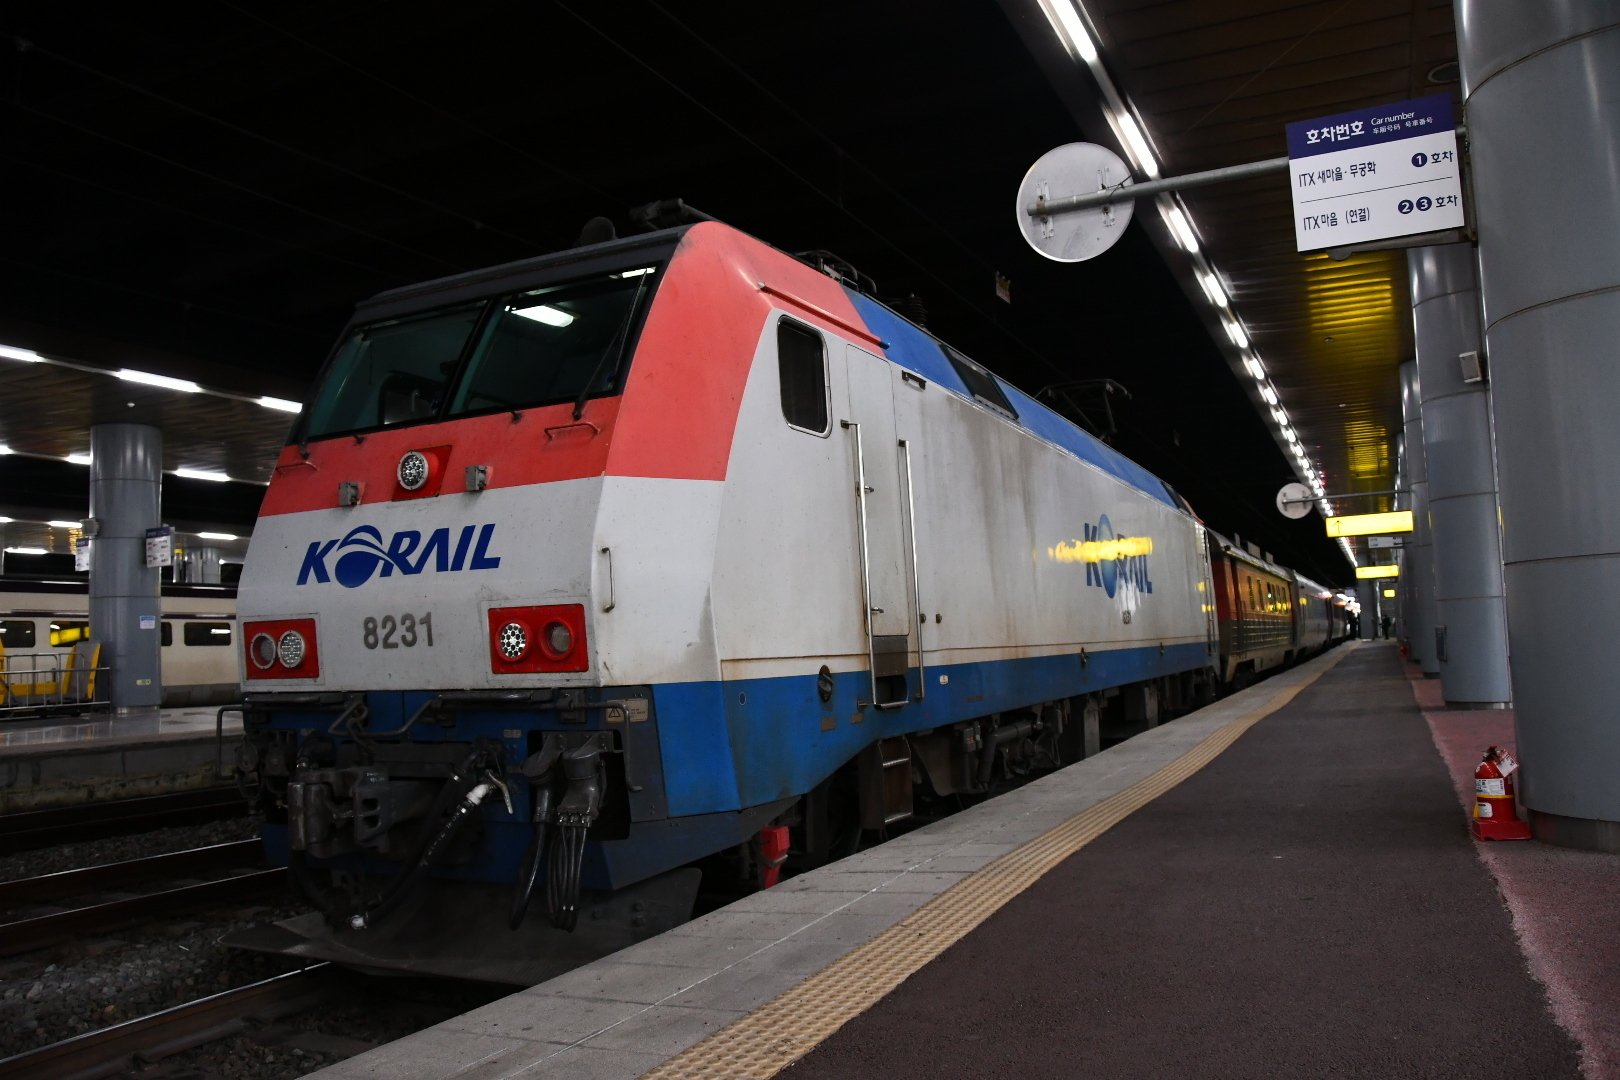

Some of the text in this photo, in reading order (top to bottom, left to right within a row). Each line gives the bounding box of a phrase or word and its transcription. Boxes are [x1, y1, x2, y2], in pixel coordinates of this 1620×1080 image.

[1371, 111, 1416, 126] Car number
[1306, 120, 1365, 145] 호차번호
[1430, 150, 1454, 164] 호차
[1298, 171, 1316, 188] ITX
[1435, 194, 1459, 208] 호차
[1345, 207, 1370, 225] (연결)
[296, 523, 502, 588] KORAIL
[363, 612, 434, 650] 8231
